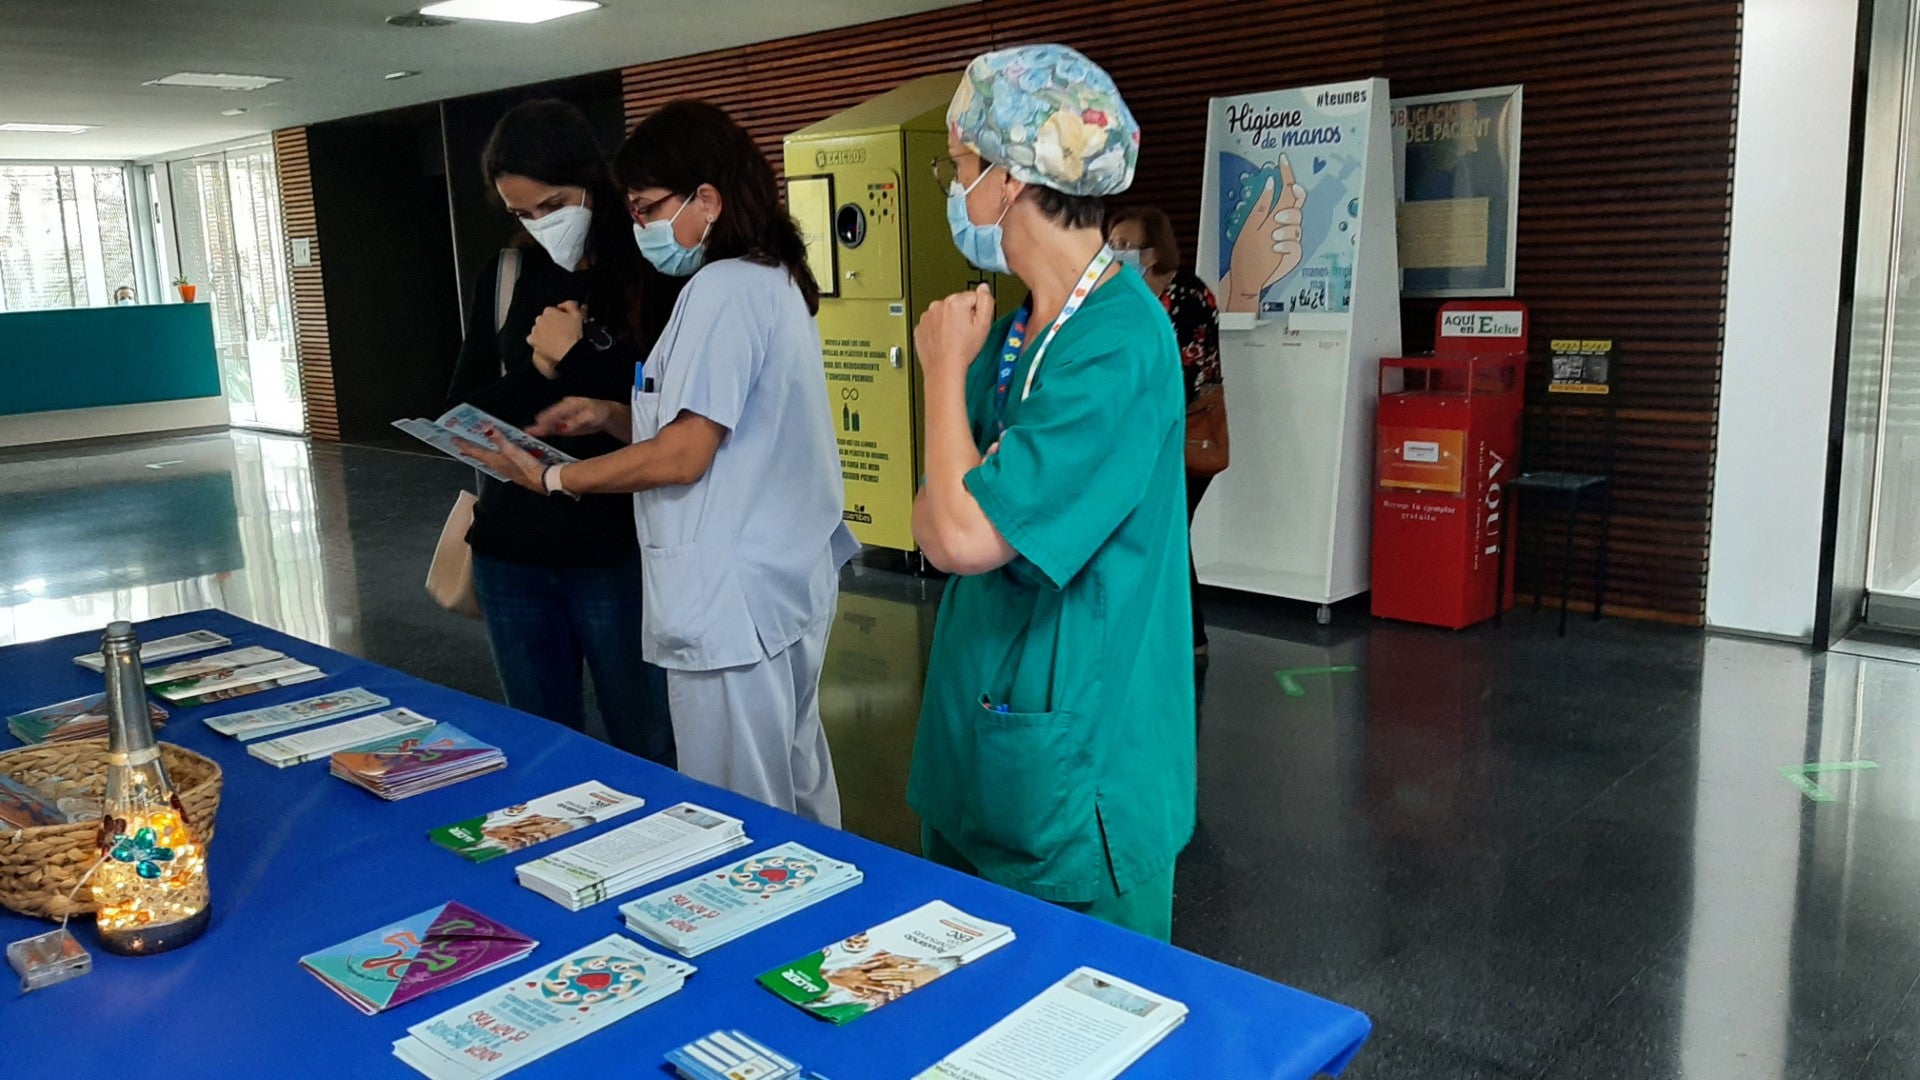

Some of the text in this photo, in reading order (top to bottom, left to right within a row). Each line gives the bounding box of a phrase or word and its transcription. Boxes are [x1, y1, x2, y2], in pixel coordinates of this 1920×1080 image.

[1317, 90, 1367, 107] #teunes
[1226, 102, 1302, 146] Higiene
[1261, 125, 1341, 149] de manos
[1444, 313, 1475, 326] AQUÍ
[1460, 316, 1519, 334] en Elche
